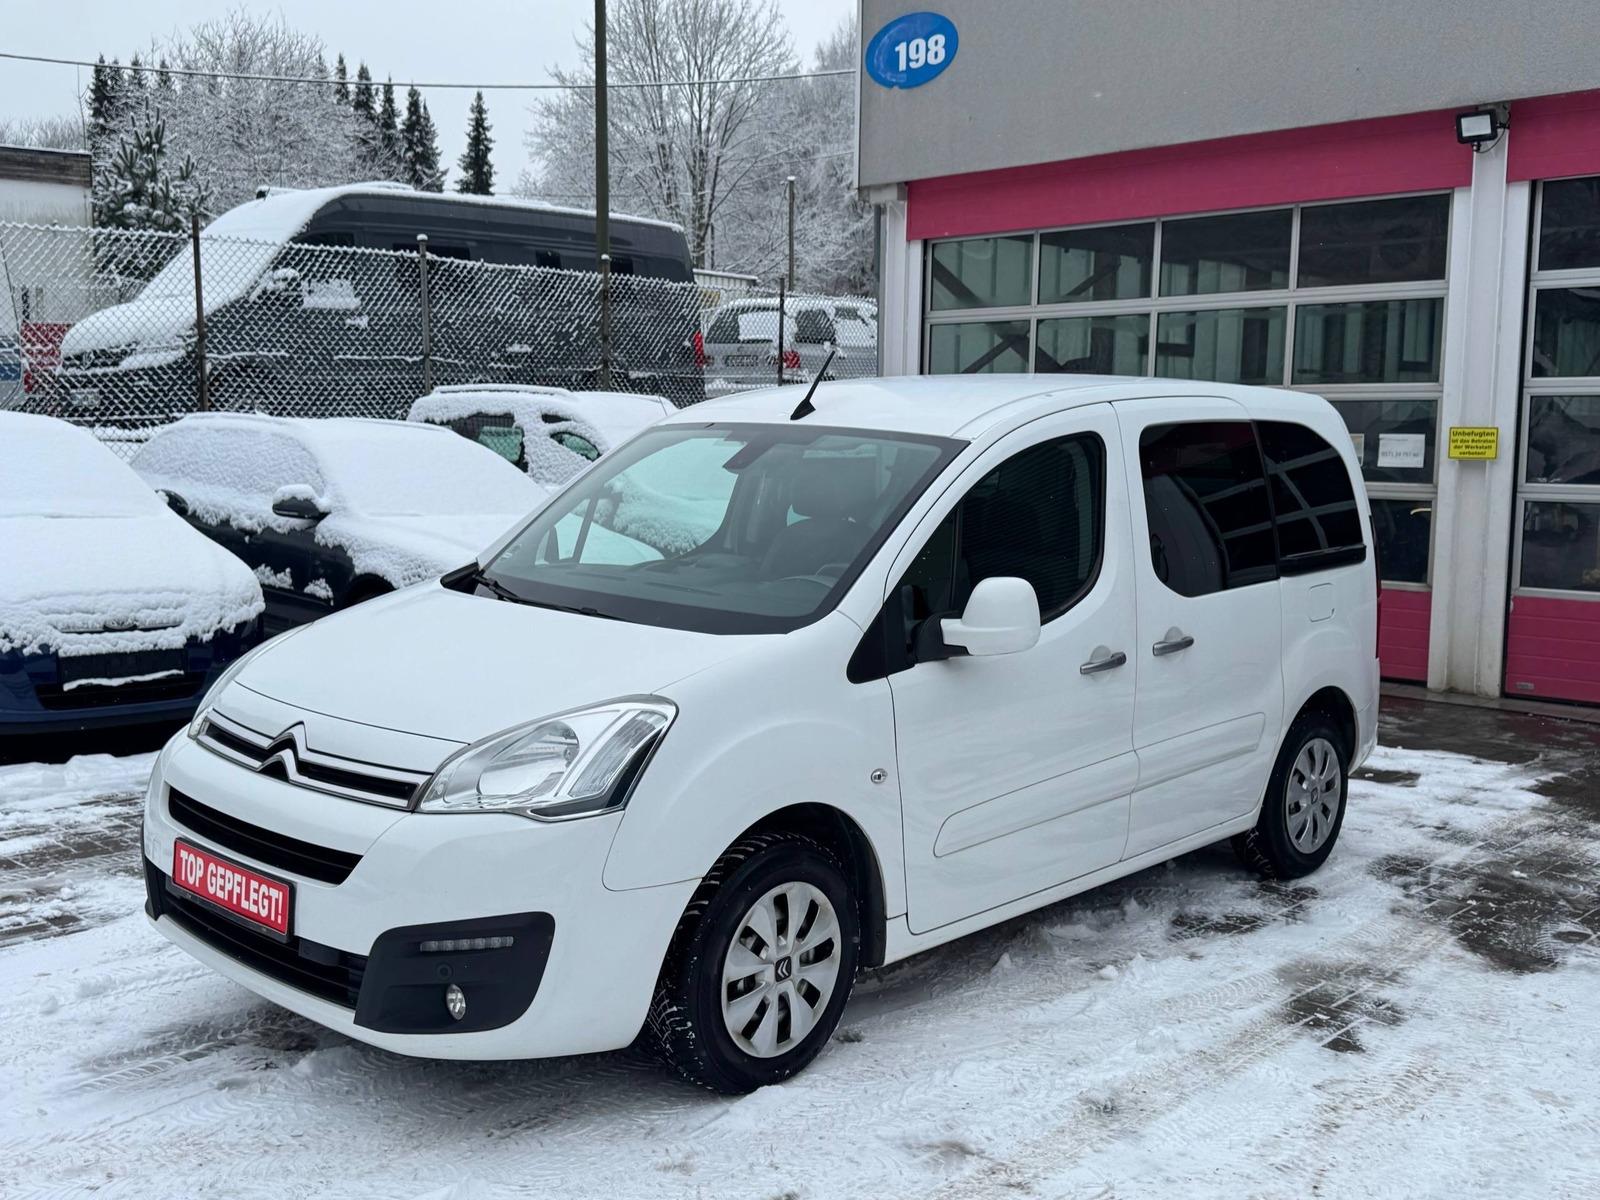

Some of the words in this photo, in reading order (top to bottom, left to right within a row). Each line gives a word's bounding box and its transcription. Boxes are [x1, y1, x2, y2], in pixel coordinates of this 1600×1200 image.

[895, 33, 946, 72] 198
[1452, 430, 1495, 438] Unbefugten
[180, 849, 205, 888] TOP
[207, 862, 284, 925] GEPFLEGT!
